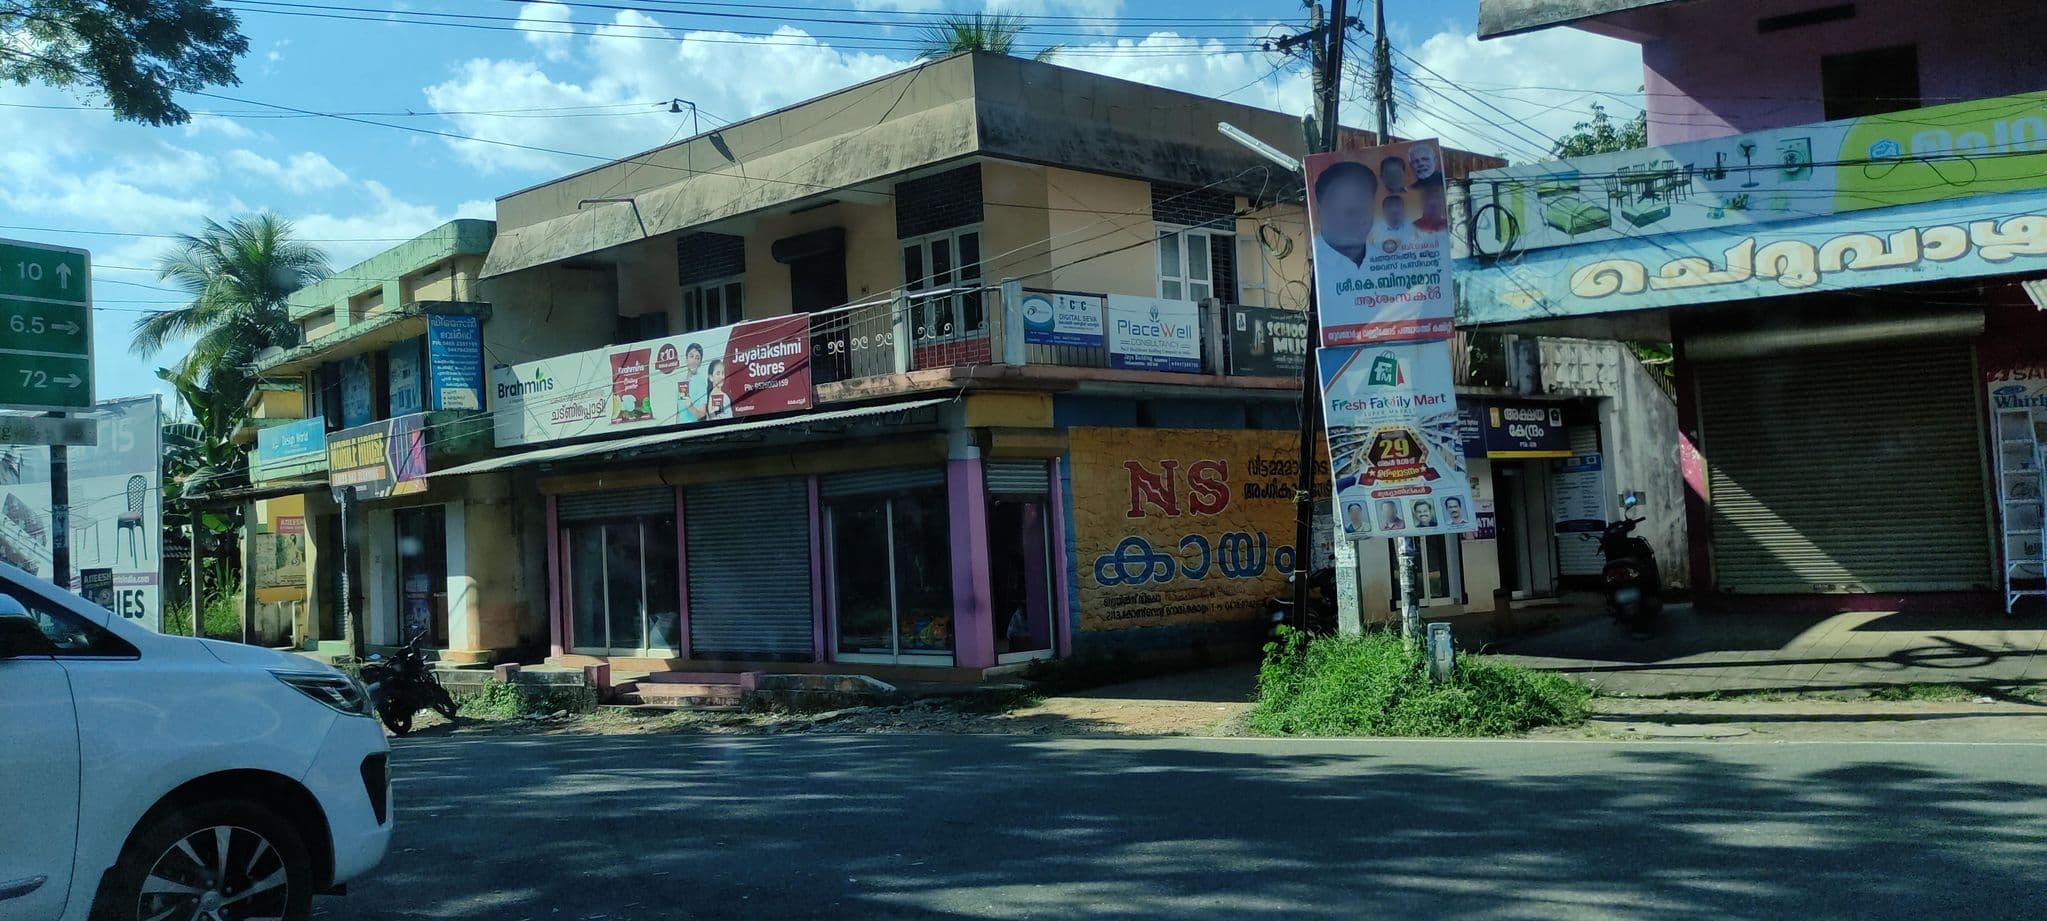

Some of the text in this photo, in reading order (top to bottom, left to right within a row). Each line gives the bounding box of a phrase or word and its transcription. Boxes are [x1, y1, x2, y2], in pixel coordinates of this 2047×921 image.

[18, 261, 43, 281] 10
[10, 314, 46, 334] 6.5
[1117, 319, 1192, 340] PlaceWell
[1266, 322, 1307, 338] SCHOO
[732, 337, 802, 366] Jayalakshmi
[19, 369, 48, 388] 72
[748, 361, 786, 378] Stores
[497, 377, 554, 399] Brahmins
[1332, 397, 1367, 412] Fresh
[1413, 392, 1447, 407] Mart
[1378, 437, 1410, 460] 29
[1124, 459, 1232, 519] NS
[1094, 531, 1297, 587] കായം
[116, 589, 145, 619] IES
